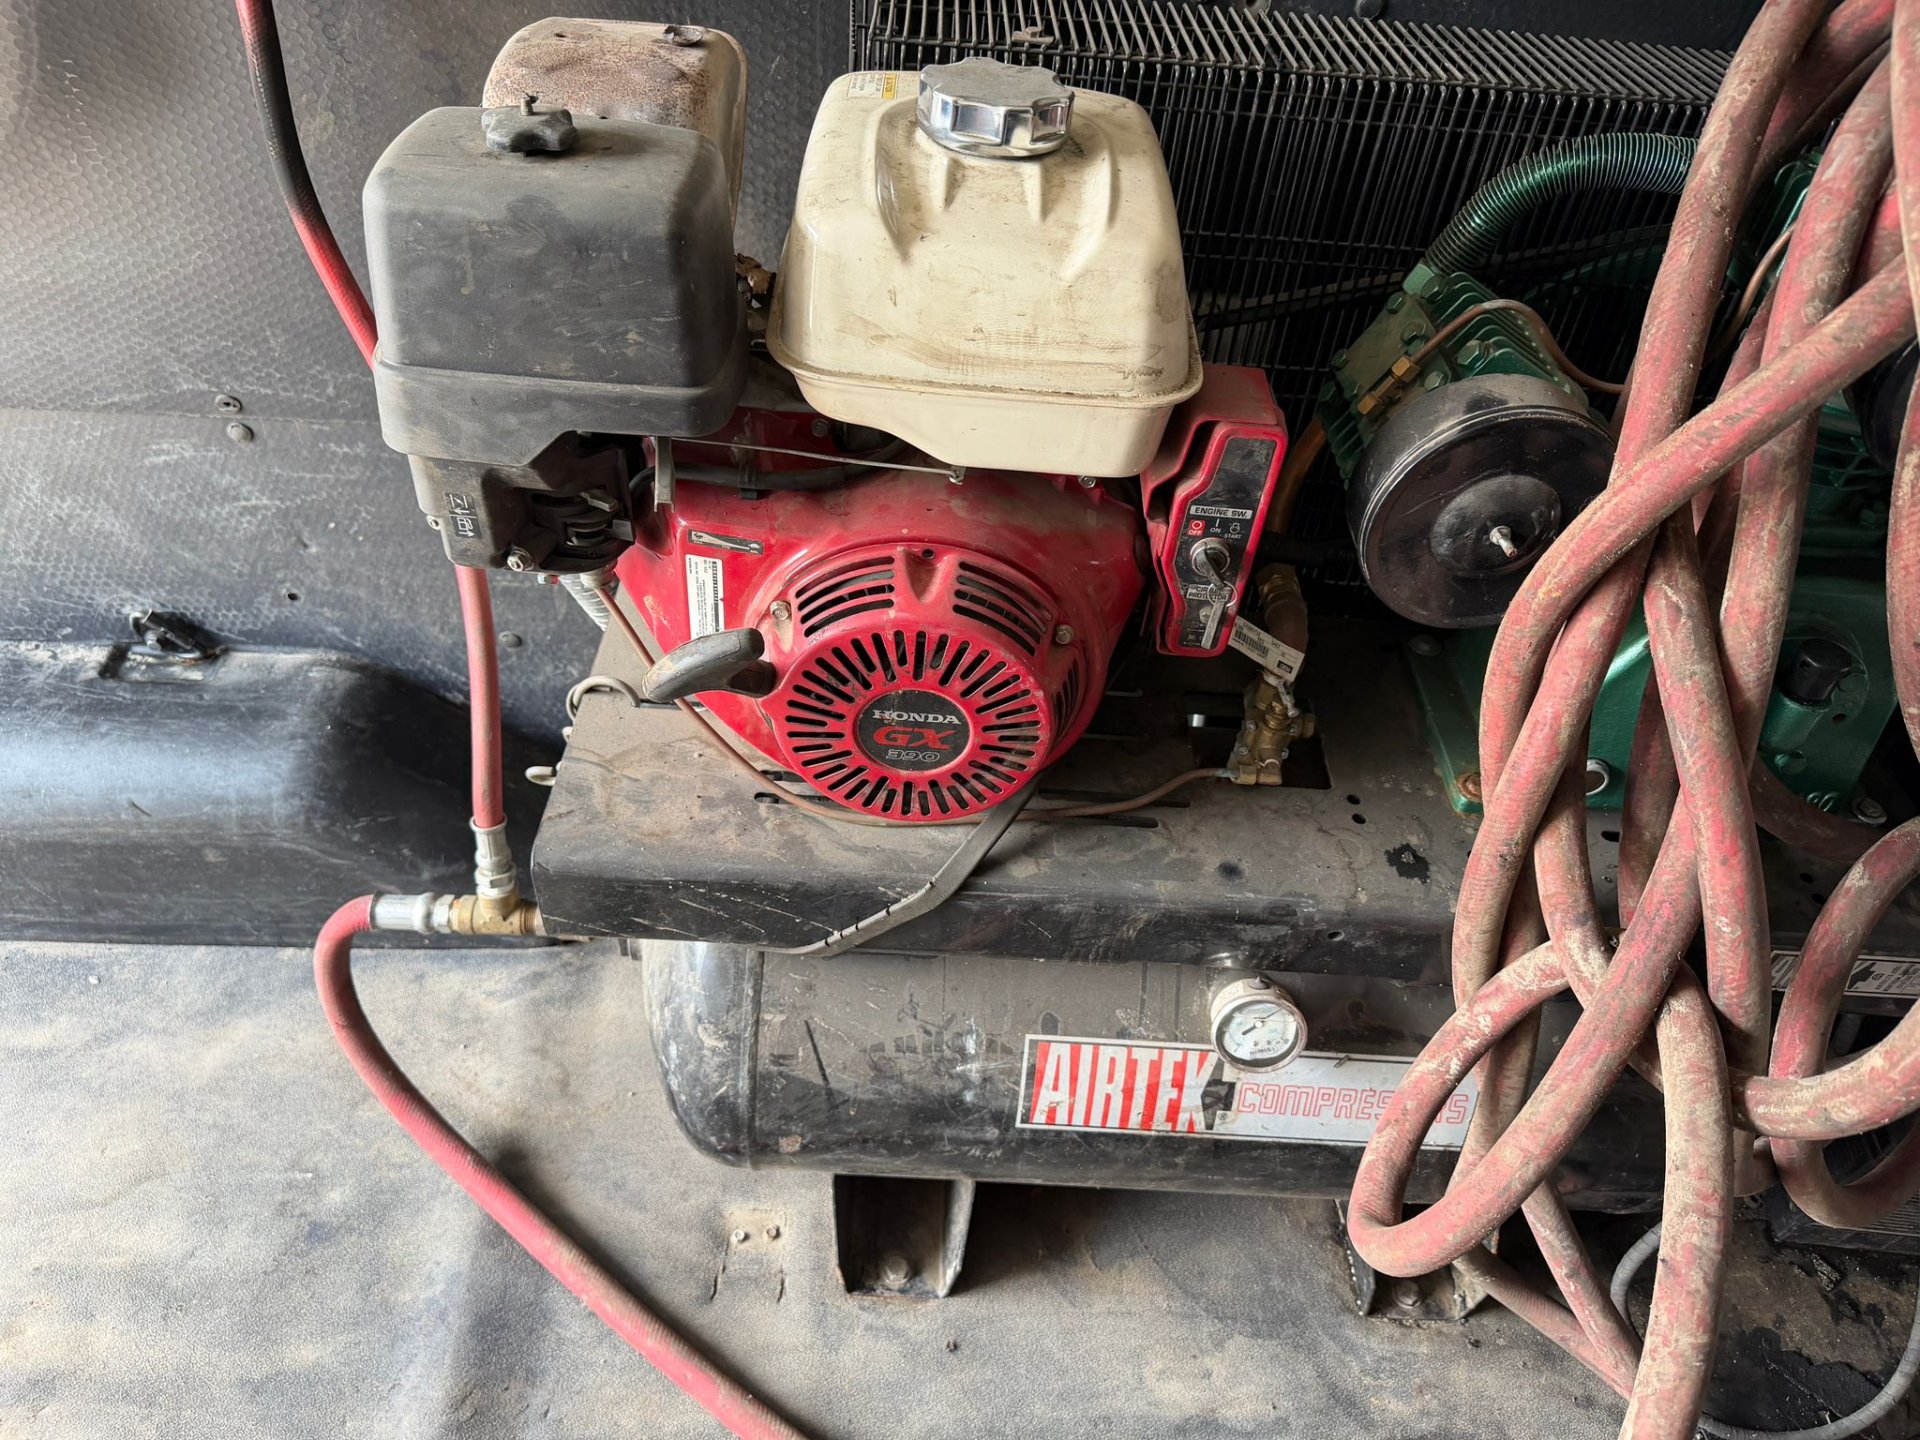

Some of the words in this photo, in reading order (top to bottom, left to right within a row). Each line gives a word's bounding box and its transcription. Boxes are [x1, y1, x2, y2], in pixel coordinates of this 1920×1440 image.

[1194, 506, 1229, 517] ENGINE
[1230, 510, 1248, 518] SW.
[872, 709, 962, 725] HONDA
[873, 725, 957, 750] GX
[886, 748, 940, 763] 390
[1032, 1042, 1218, 1133] AIRTEK
[1238, 1082, 1469, 1124] COMPRESS
